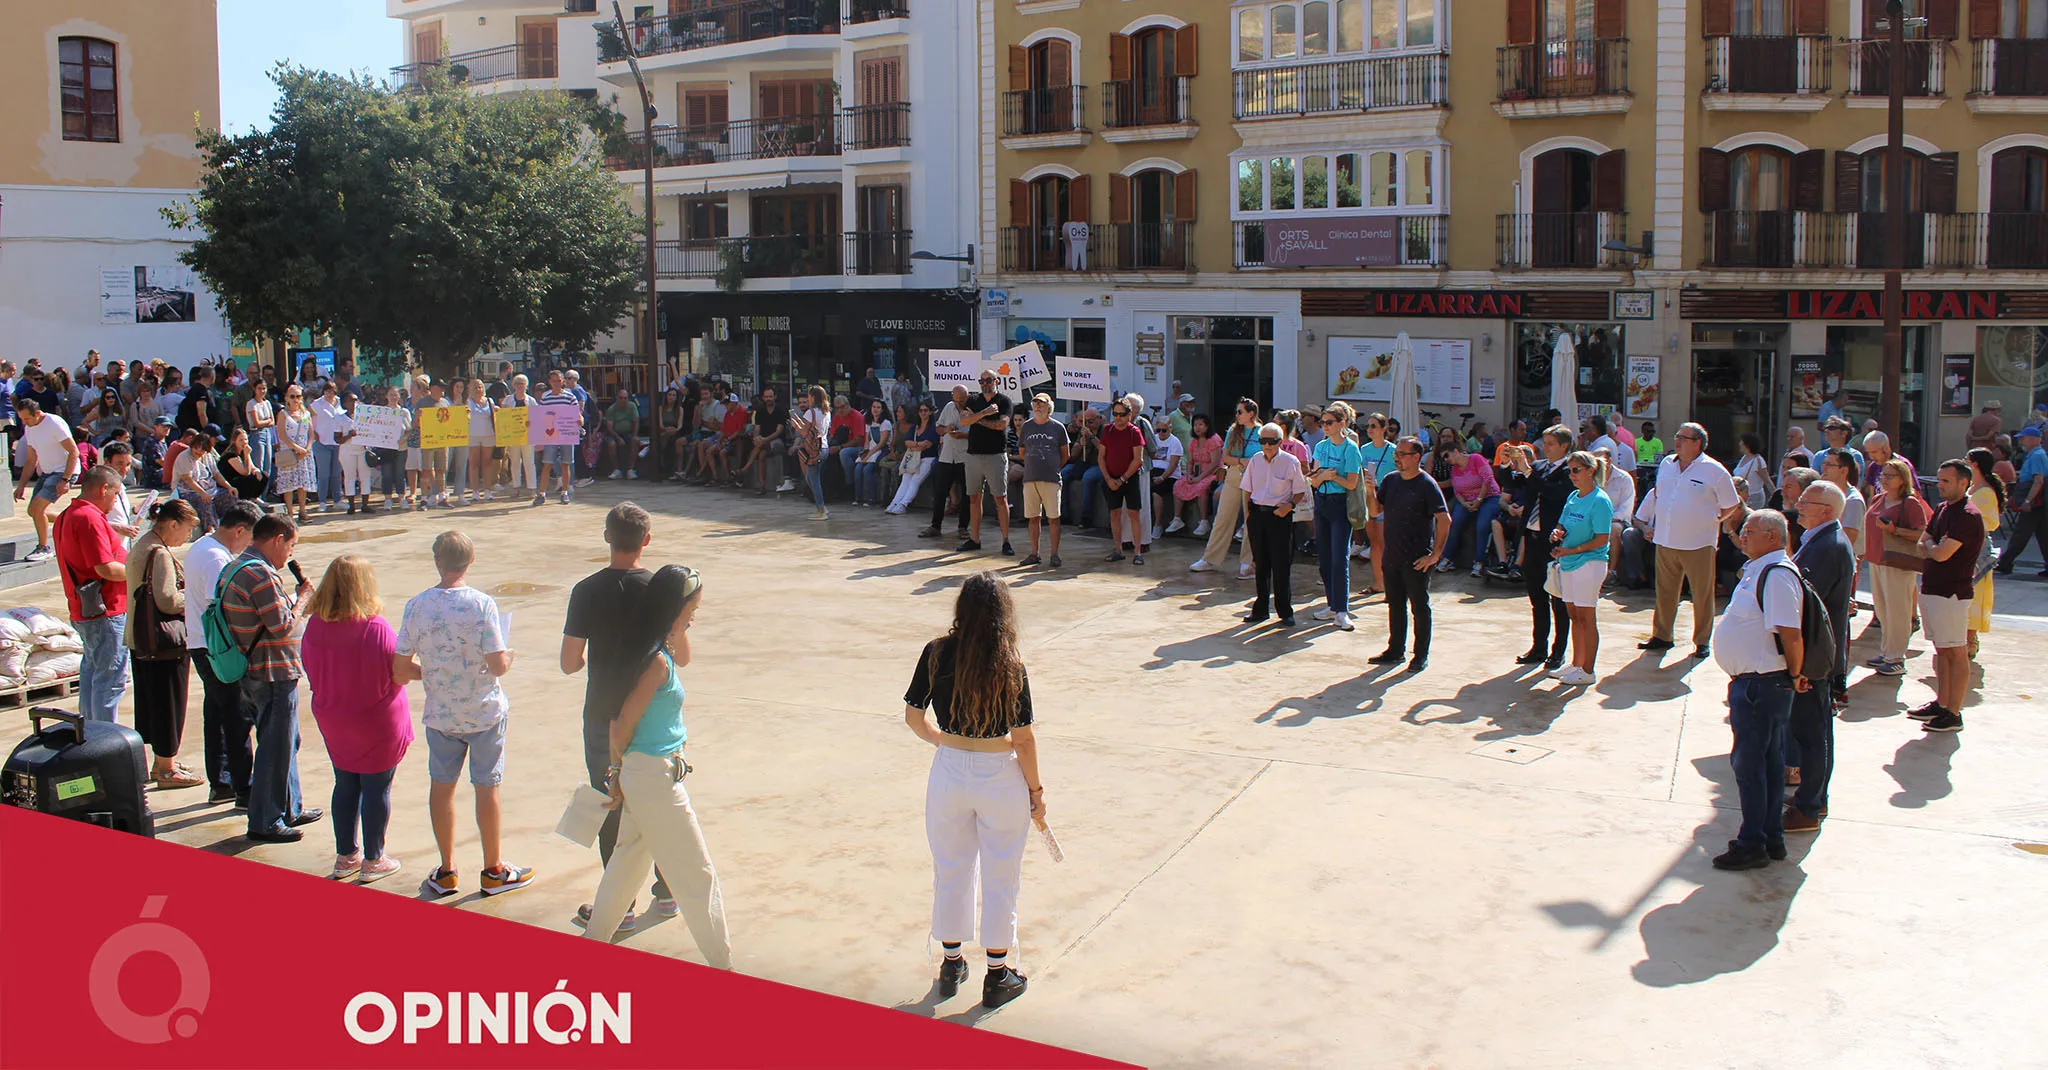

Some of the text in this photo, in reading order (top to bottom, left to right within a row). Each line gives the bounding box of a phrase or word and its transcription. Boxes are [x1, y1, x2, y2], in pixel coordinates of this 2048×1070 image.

[1279, 230, 1310, 241] ORTS
[1361, 228, 1393, 239] Dental
[1375, 293, 1522, 315] LIZARRAN
[740, 315, 791, 331] THE GOOD BURGER
[865, 319, 946, 331] WE LOVE BURGERS
[711, 317, 729, 341] TGB
[933, 359, 962, 368] SALUT
[933, 373, 976, 381] MUNDIAL.
[1063, 381, 1104, 391] UNIVERSAL.
